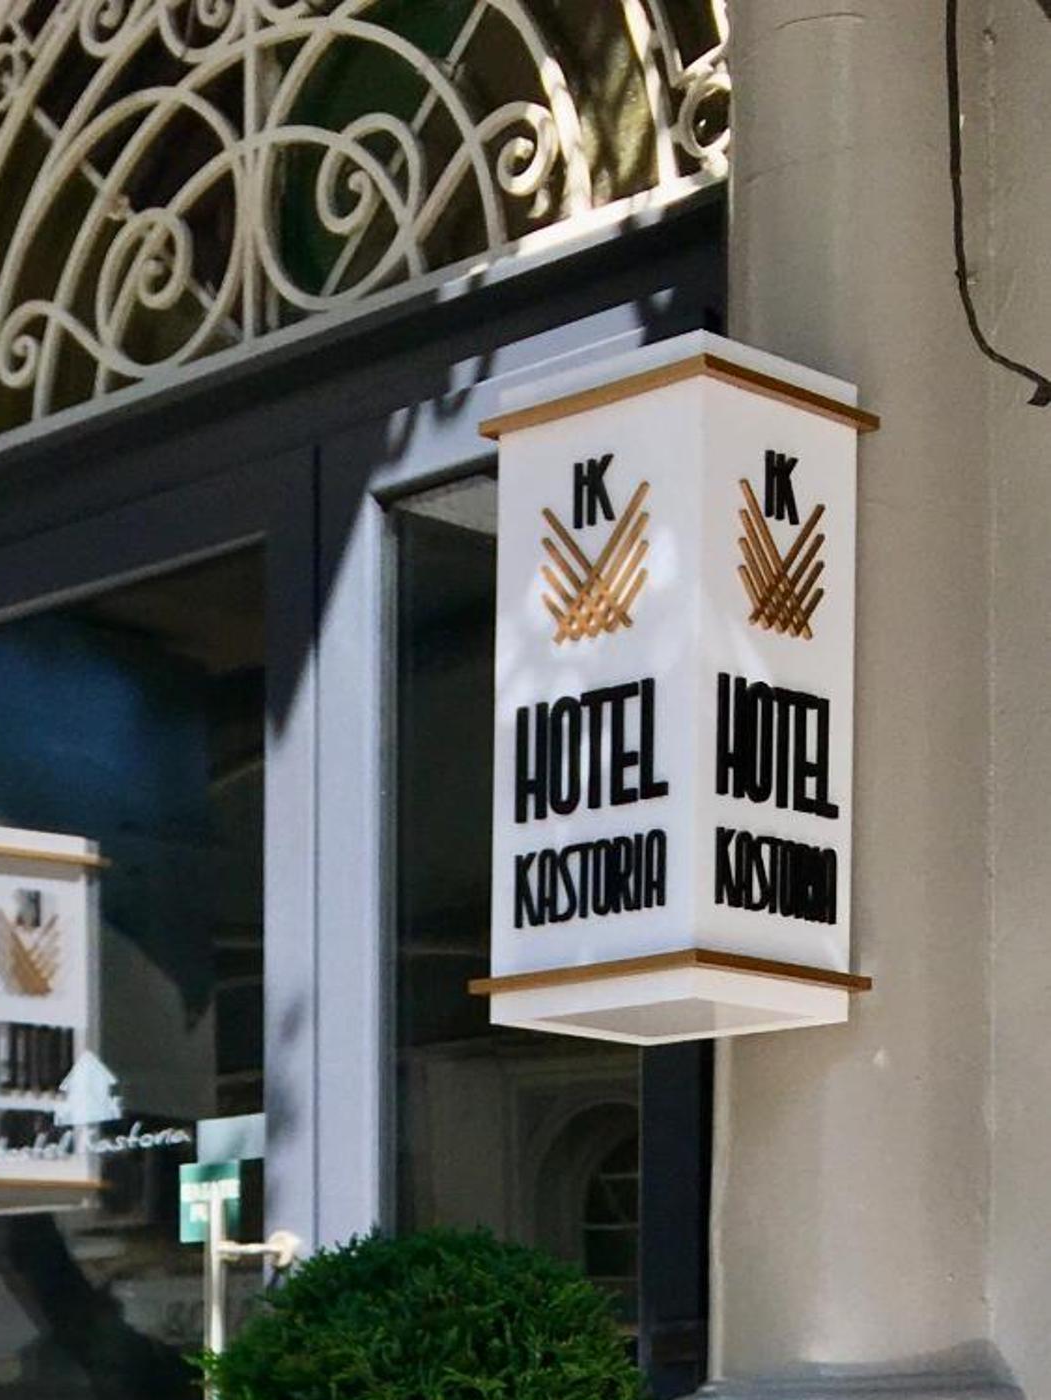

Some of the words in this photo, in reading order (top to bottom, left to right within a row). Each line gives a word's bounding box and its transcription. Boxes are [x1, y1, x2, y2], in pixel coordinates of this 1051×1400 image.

[514, 677, 669, 824] HOTEL
[716, 672, 839, 820] HOTEL
[513, 828, 668, 929] KASTORIA
